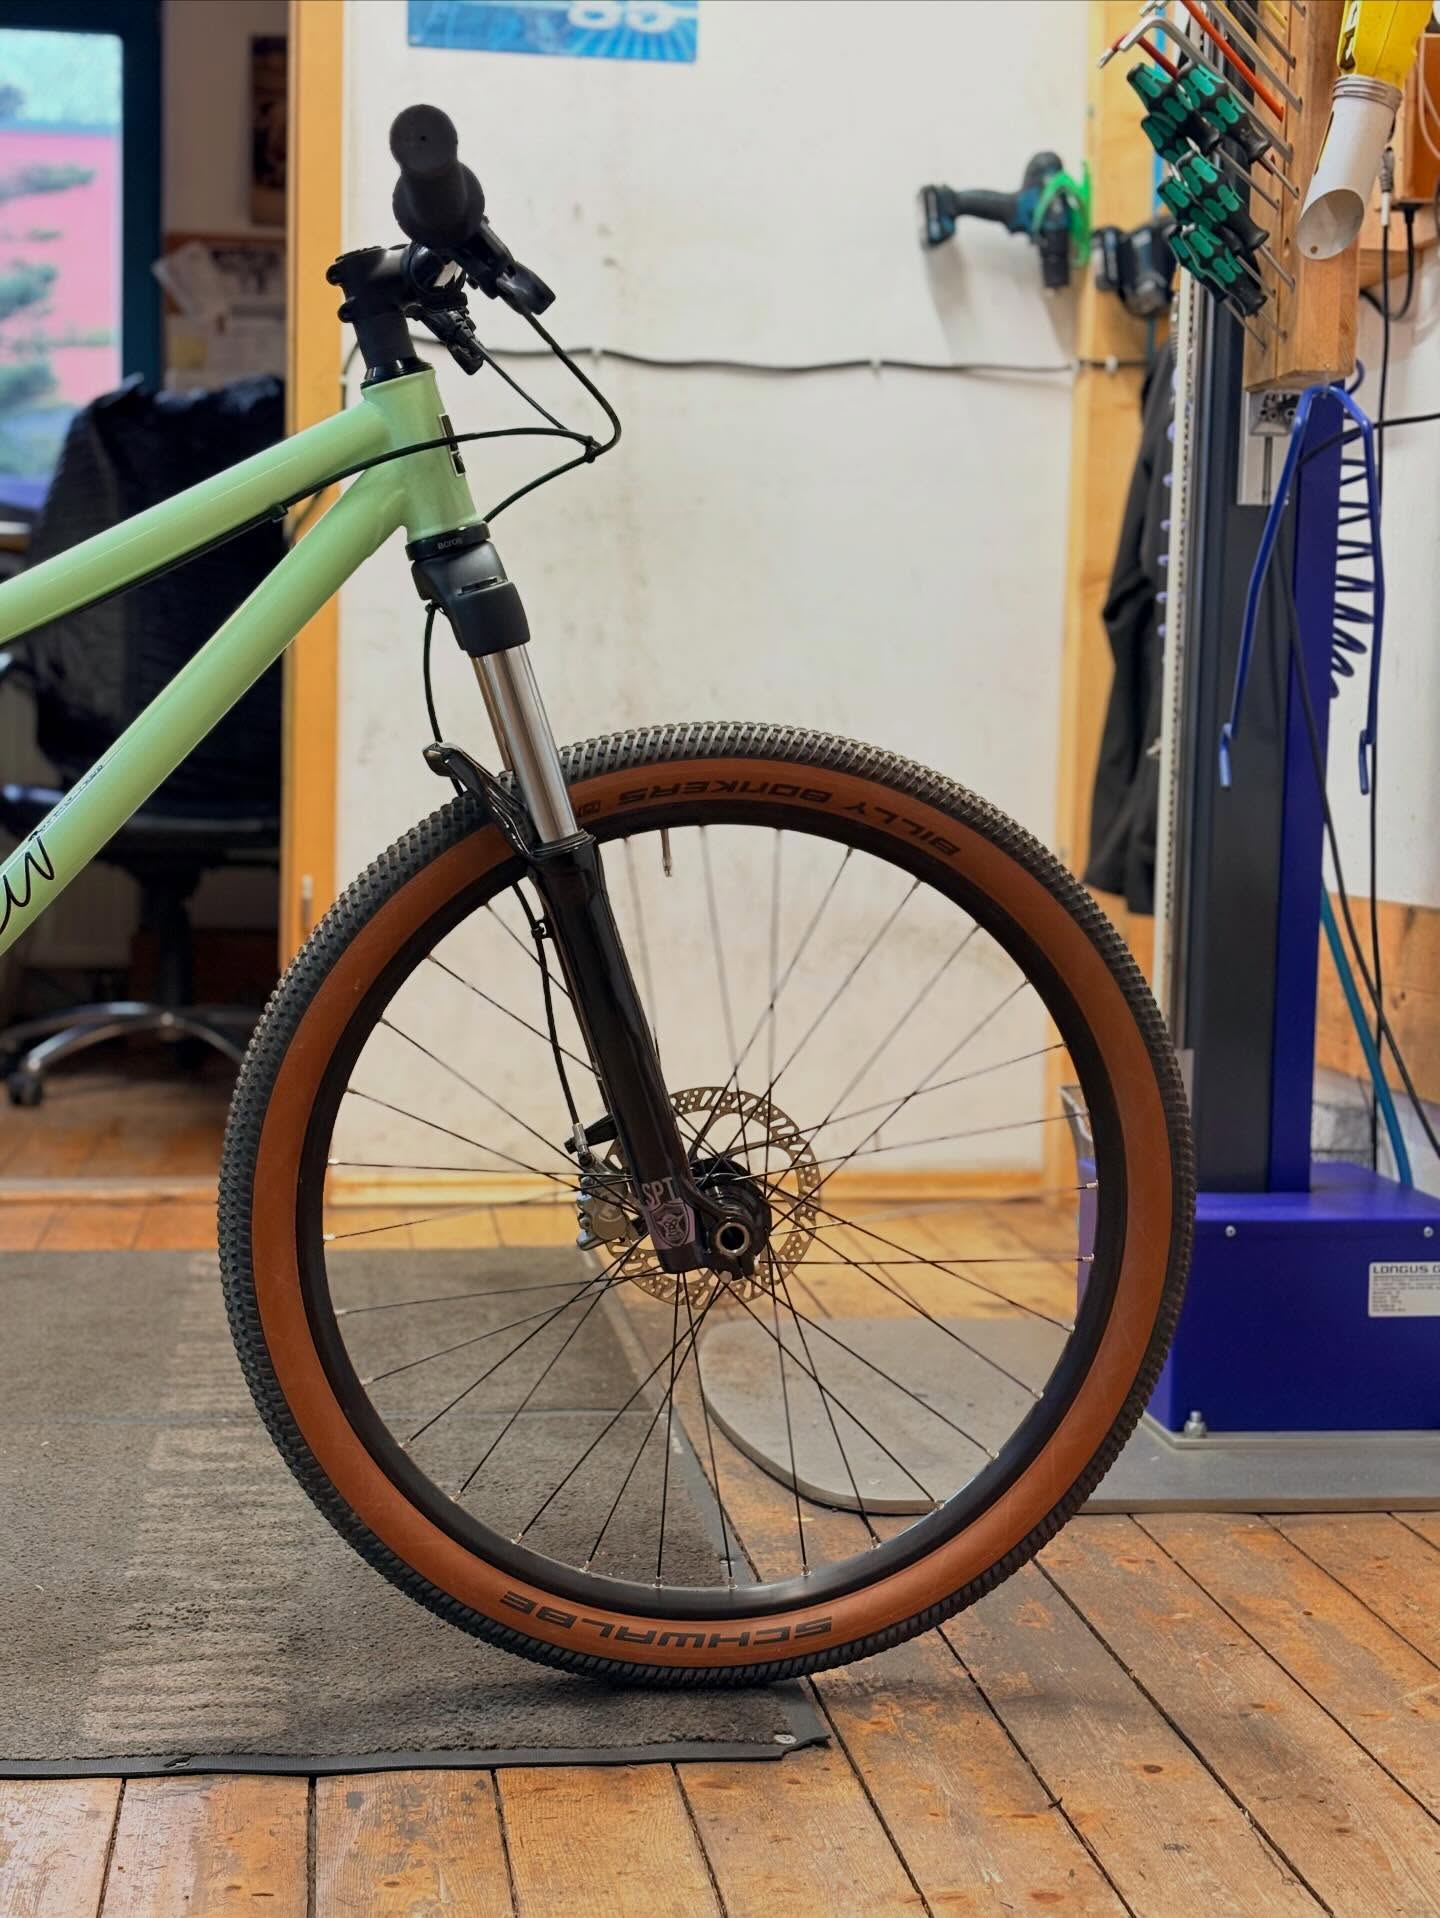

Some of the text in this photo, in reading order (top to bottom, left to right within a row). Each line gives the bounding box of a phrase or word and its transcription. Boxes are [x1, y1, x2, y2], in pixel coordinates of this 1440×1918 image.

[619, 779, 961, 858] BILLY BONKERS
[1373, 1264, 1428, 1273] LONGUS
[502, 1590, 833, 1649] SCHWALBE
